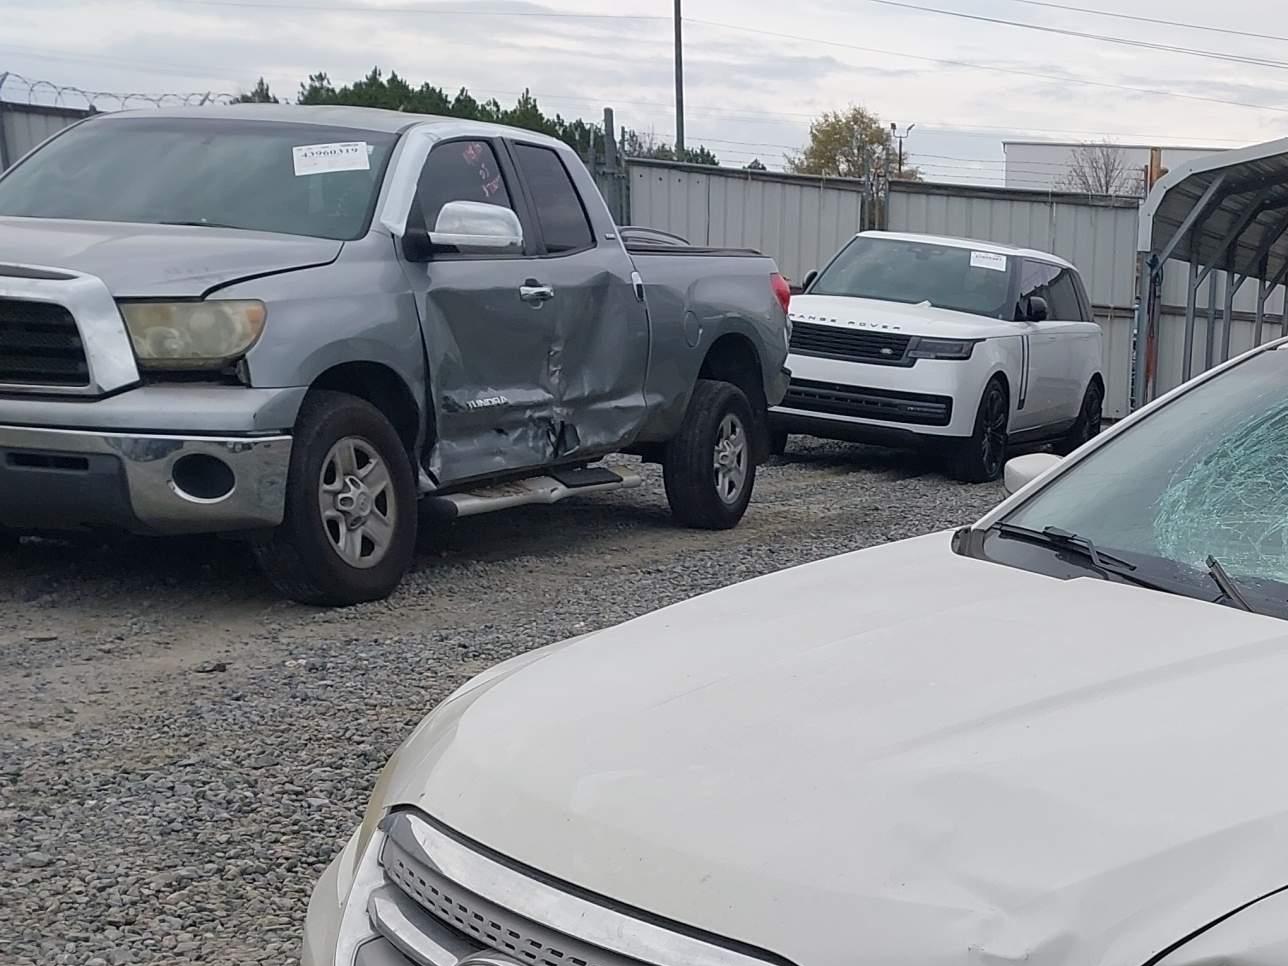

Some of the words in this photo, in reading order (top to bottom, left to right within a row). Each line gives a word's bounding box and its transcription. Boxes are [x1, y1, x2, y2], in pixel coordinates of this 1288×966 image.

[788, 313, 837, 323] RANGE
[847, 320, 902, 330] ROVER
[466, 395, 508, 409] TUNDRA
